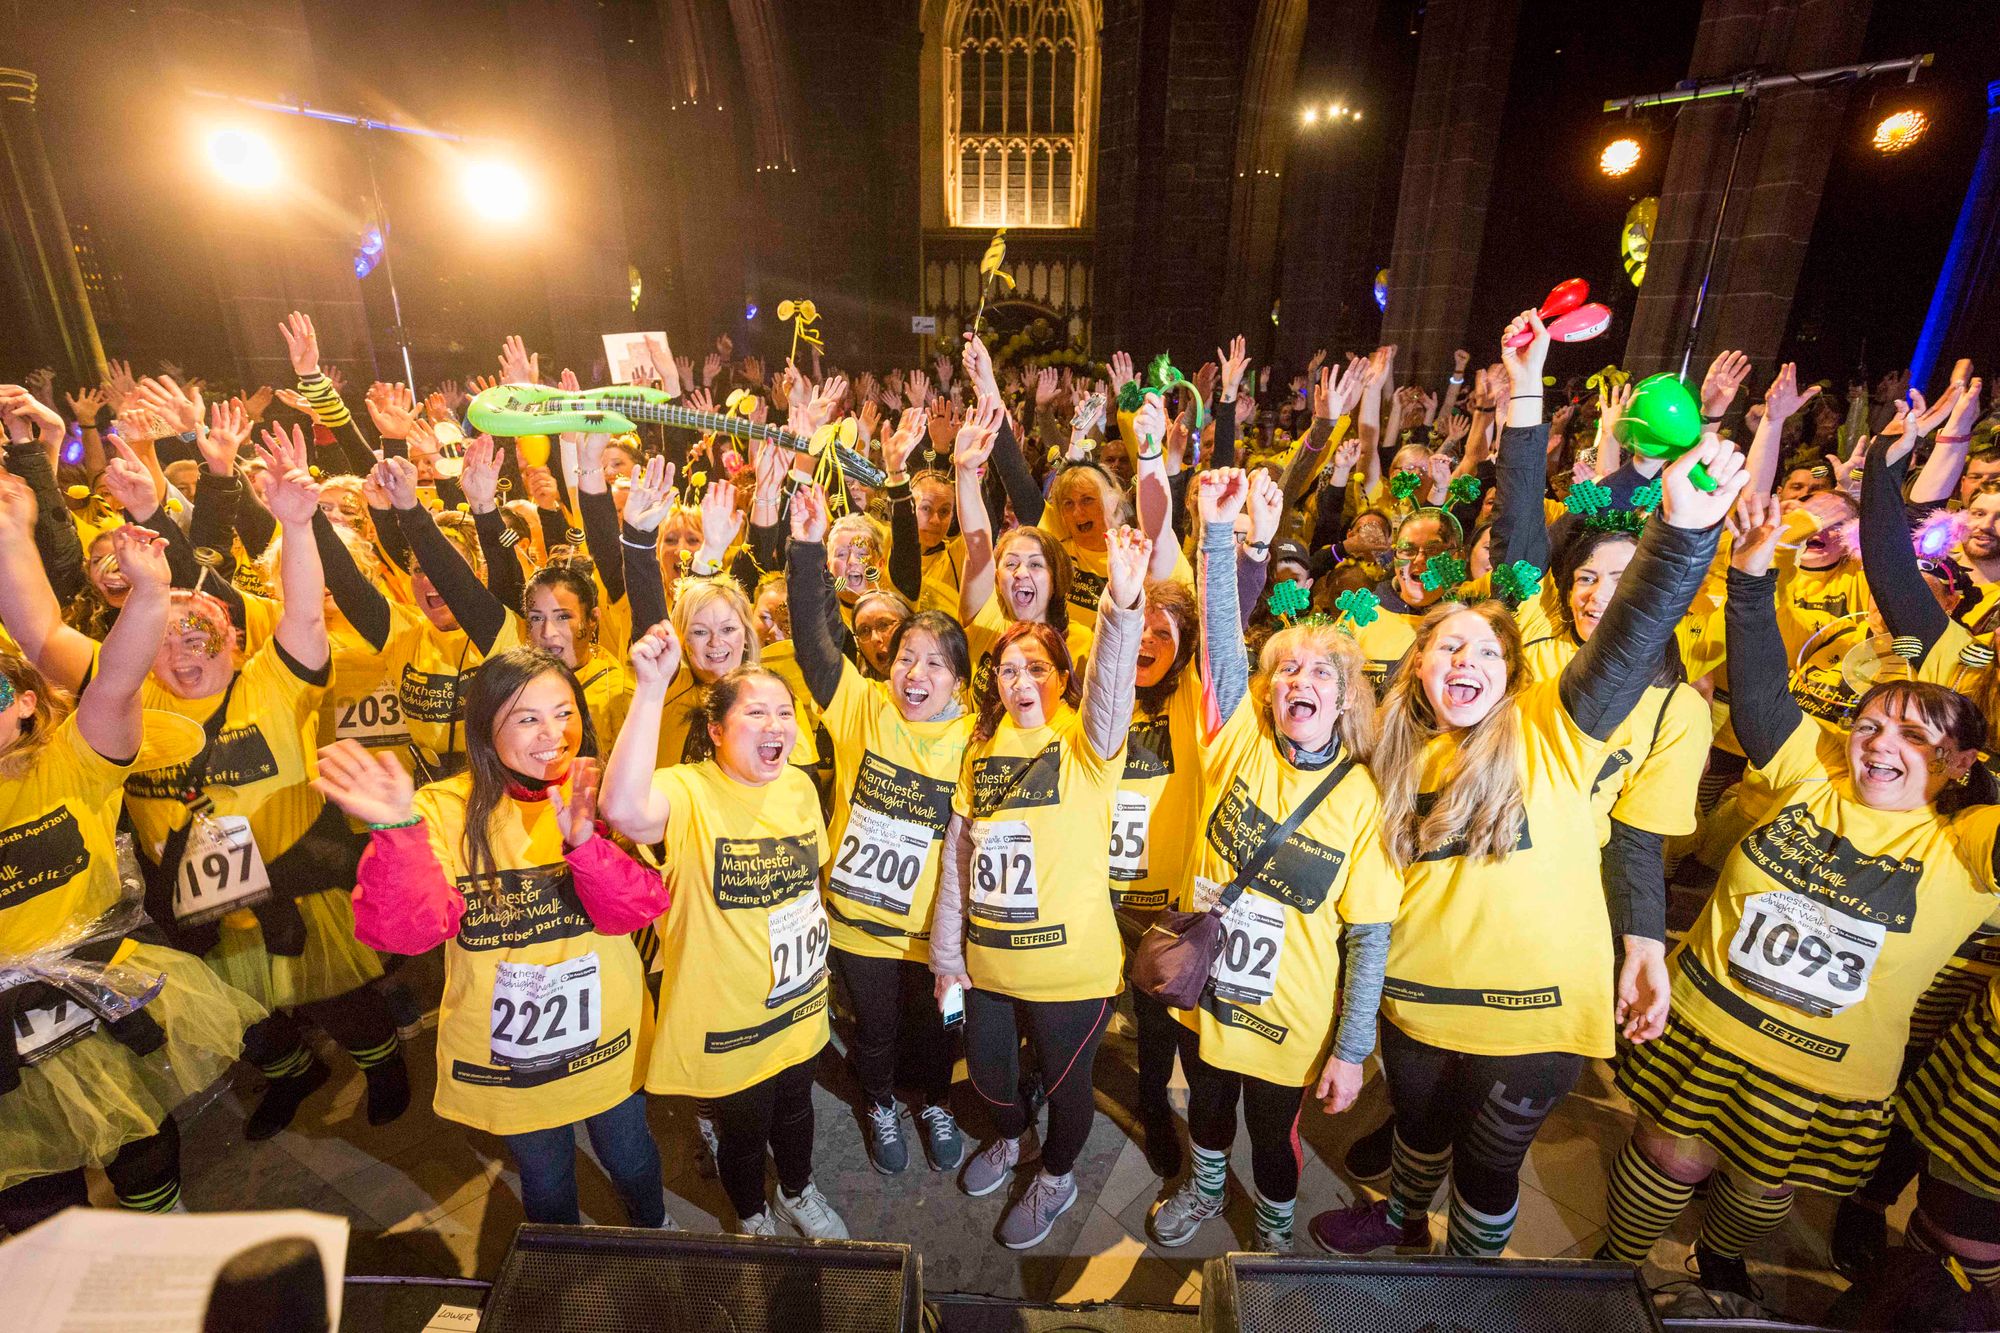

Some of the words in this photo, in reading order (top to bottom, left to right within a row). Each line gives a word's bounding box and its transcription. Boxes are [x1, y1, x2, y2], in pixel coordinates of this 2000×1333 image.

[402, 680, 454, 699] ancheste
[338, 694, 407, 729] 203
[859, 779, 907, 810] Midnight
[860, 767, 926, 802] Manchester
[908, 802, 938, 819] Walk
[836, 835, 920, 891] 2200
[1286, 836, 1298, 845] th
[1300, 841, 1322, 857] April
[1322, 851, 1342, 865] 2019
[721, 855, 794, 872] Manchester
[782, 864, 809, 881] Walk
[973, 853, 1033, 896] 812
[1811, 863, 1847, 888] Walk
[1877, 860, 1896, 872] Apr
[0, 881, 26, 898] art
[28, 871, 45, 885] of
[47, 869, 60, 880] it
[721, 871, 781, 890] Midnight
[1255, 872, 1268, 882] rt
[1270, 877, 1284, 889] of
[1281, 885, 1293, 897] it
[1769, 861, 1784, 874] to
[1784, 867, 1807, 888] bee
[1808, 882, 1837, 899] part
[1839, 894, 1857, 908] of
[1857, 902, 1872, 916] it
[526, 898, 562, 919] Walk
[719, 890, 760, 905] Buzzing
[761, 894, 770, 903] to
[536, 917, 561, 934] part
[564, 913, 574, 924] of
[576, 914, 585, 926] it
[1800, 911, 1827, 927] Walk
[1013, 932, 1060, 945] BETFRED
[773, 917, 828, 988] 2199
[1225, 929, 1277, 980] 02
[1740, 912, 1866, 992] 1093
[497, 965, 546, 983] Manchester
[1487, 993, 1552, 1006] BETFRED
[492, 988, 589, 1046] 2221
[1233, 1012, 1280, 1039] BETFRED
[1763, 1022, 1838, 1056] BETFRED
[571, 1038, 626, 1070] BETFRED
[437, 1308, 474, 1321] LOWER
